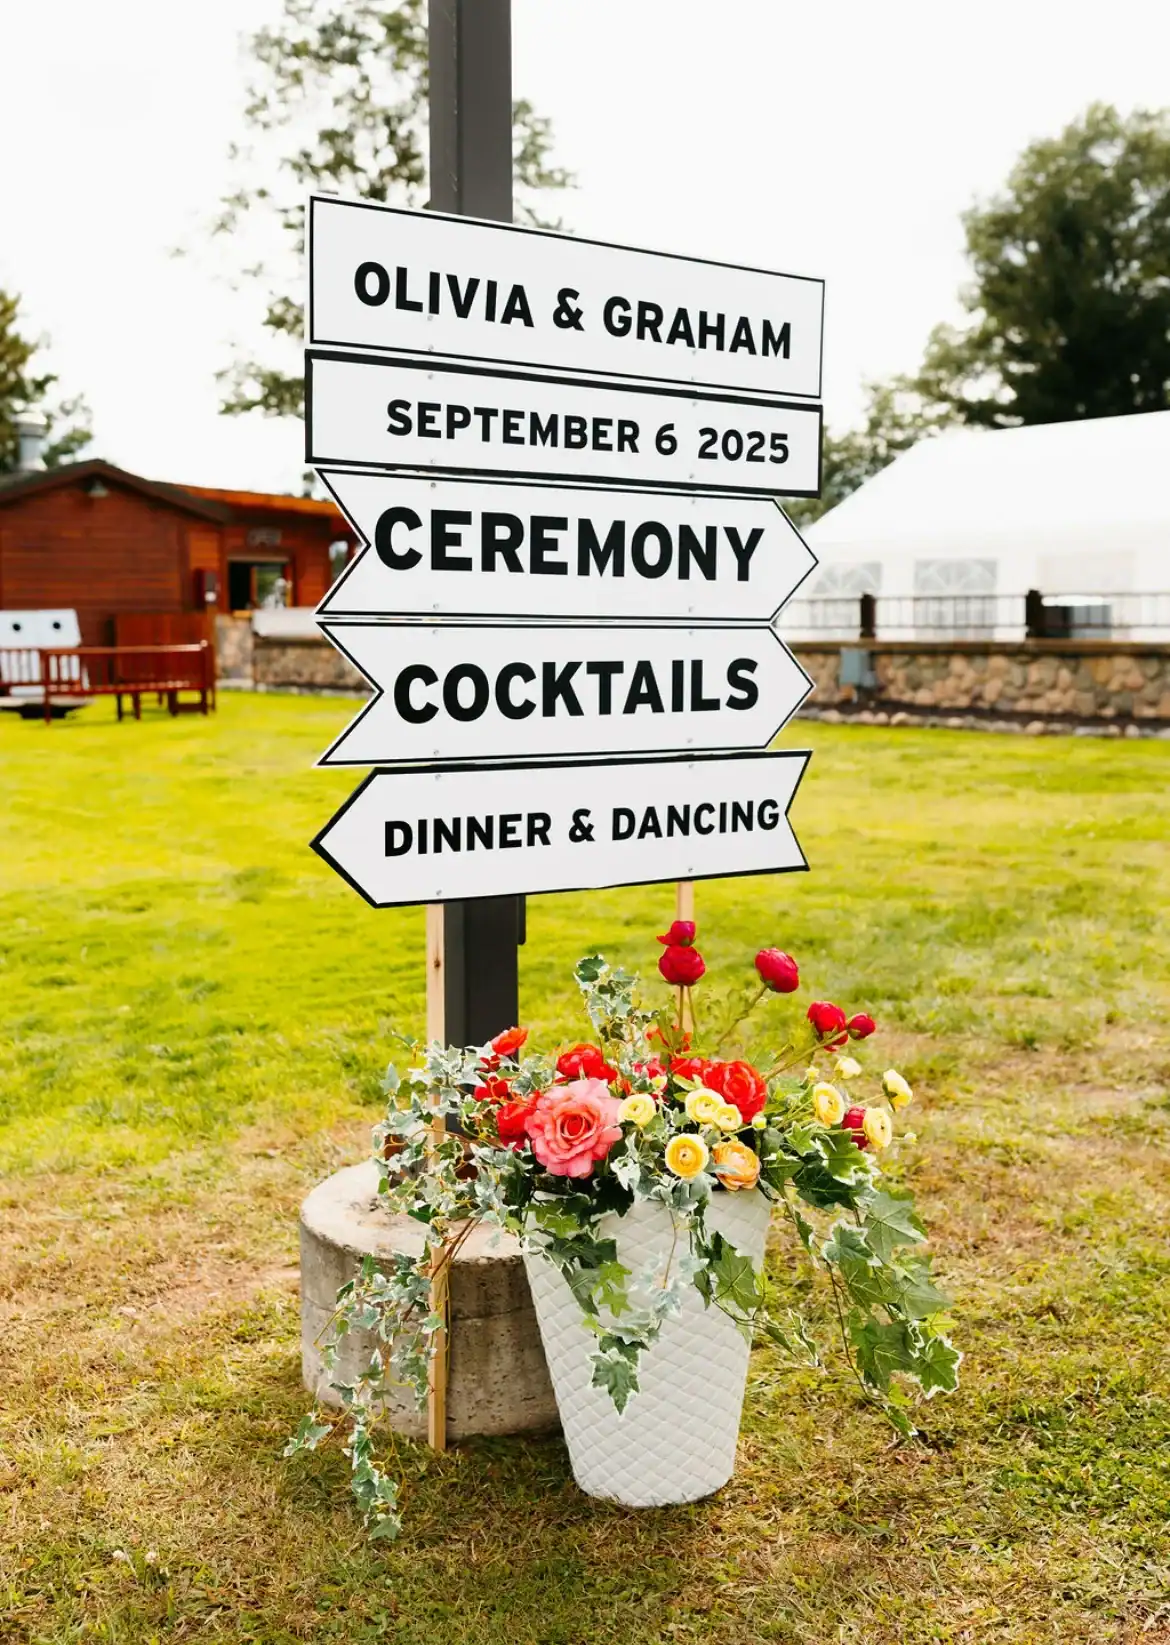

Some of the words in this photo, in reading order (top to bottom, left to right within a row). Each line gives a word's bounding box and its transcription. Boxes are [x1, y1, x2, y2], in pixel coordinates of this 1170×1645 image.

[354, 261, 535, 328] OLIVIA
[552, 287, 585, 332] &
[603, 296, 791, 360] GRAHAM
[386, 399, 640, 454] SEPTEMBER
[655, 423, 678, 456] 6
[697, 427, 789, 464] 2025
[374, 506, 765, 582] CEREMONY
[393, 659, 759, 724] COCKTAILS
[384, 813, 552, 857] DINNER
[568, 808, 595, 843] &
[612, 799, 780, 841] DANCING
